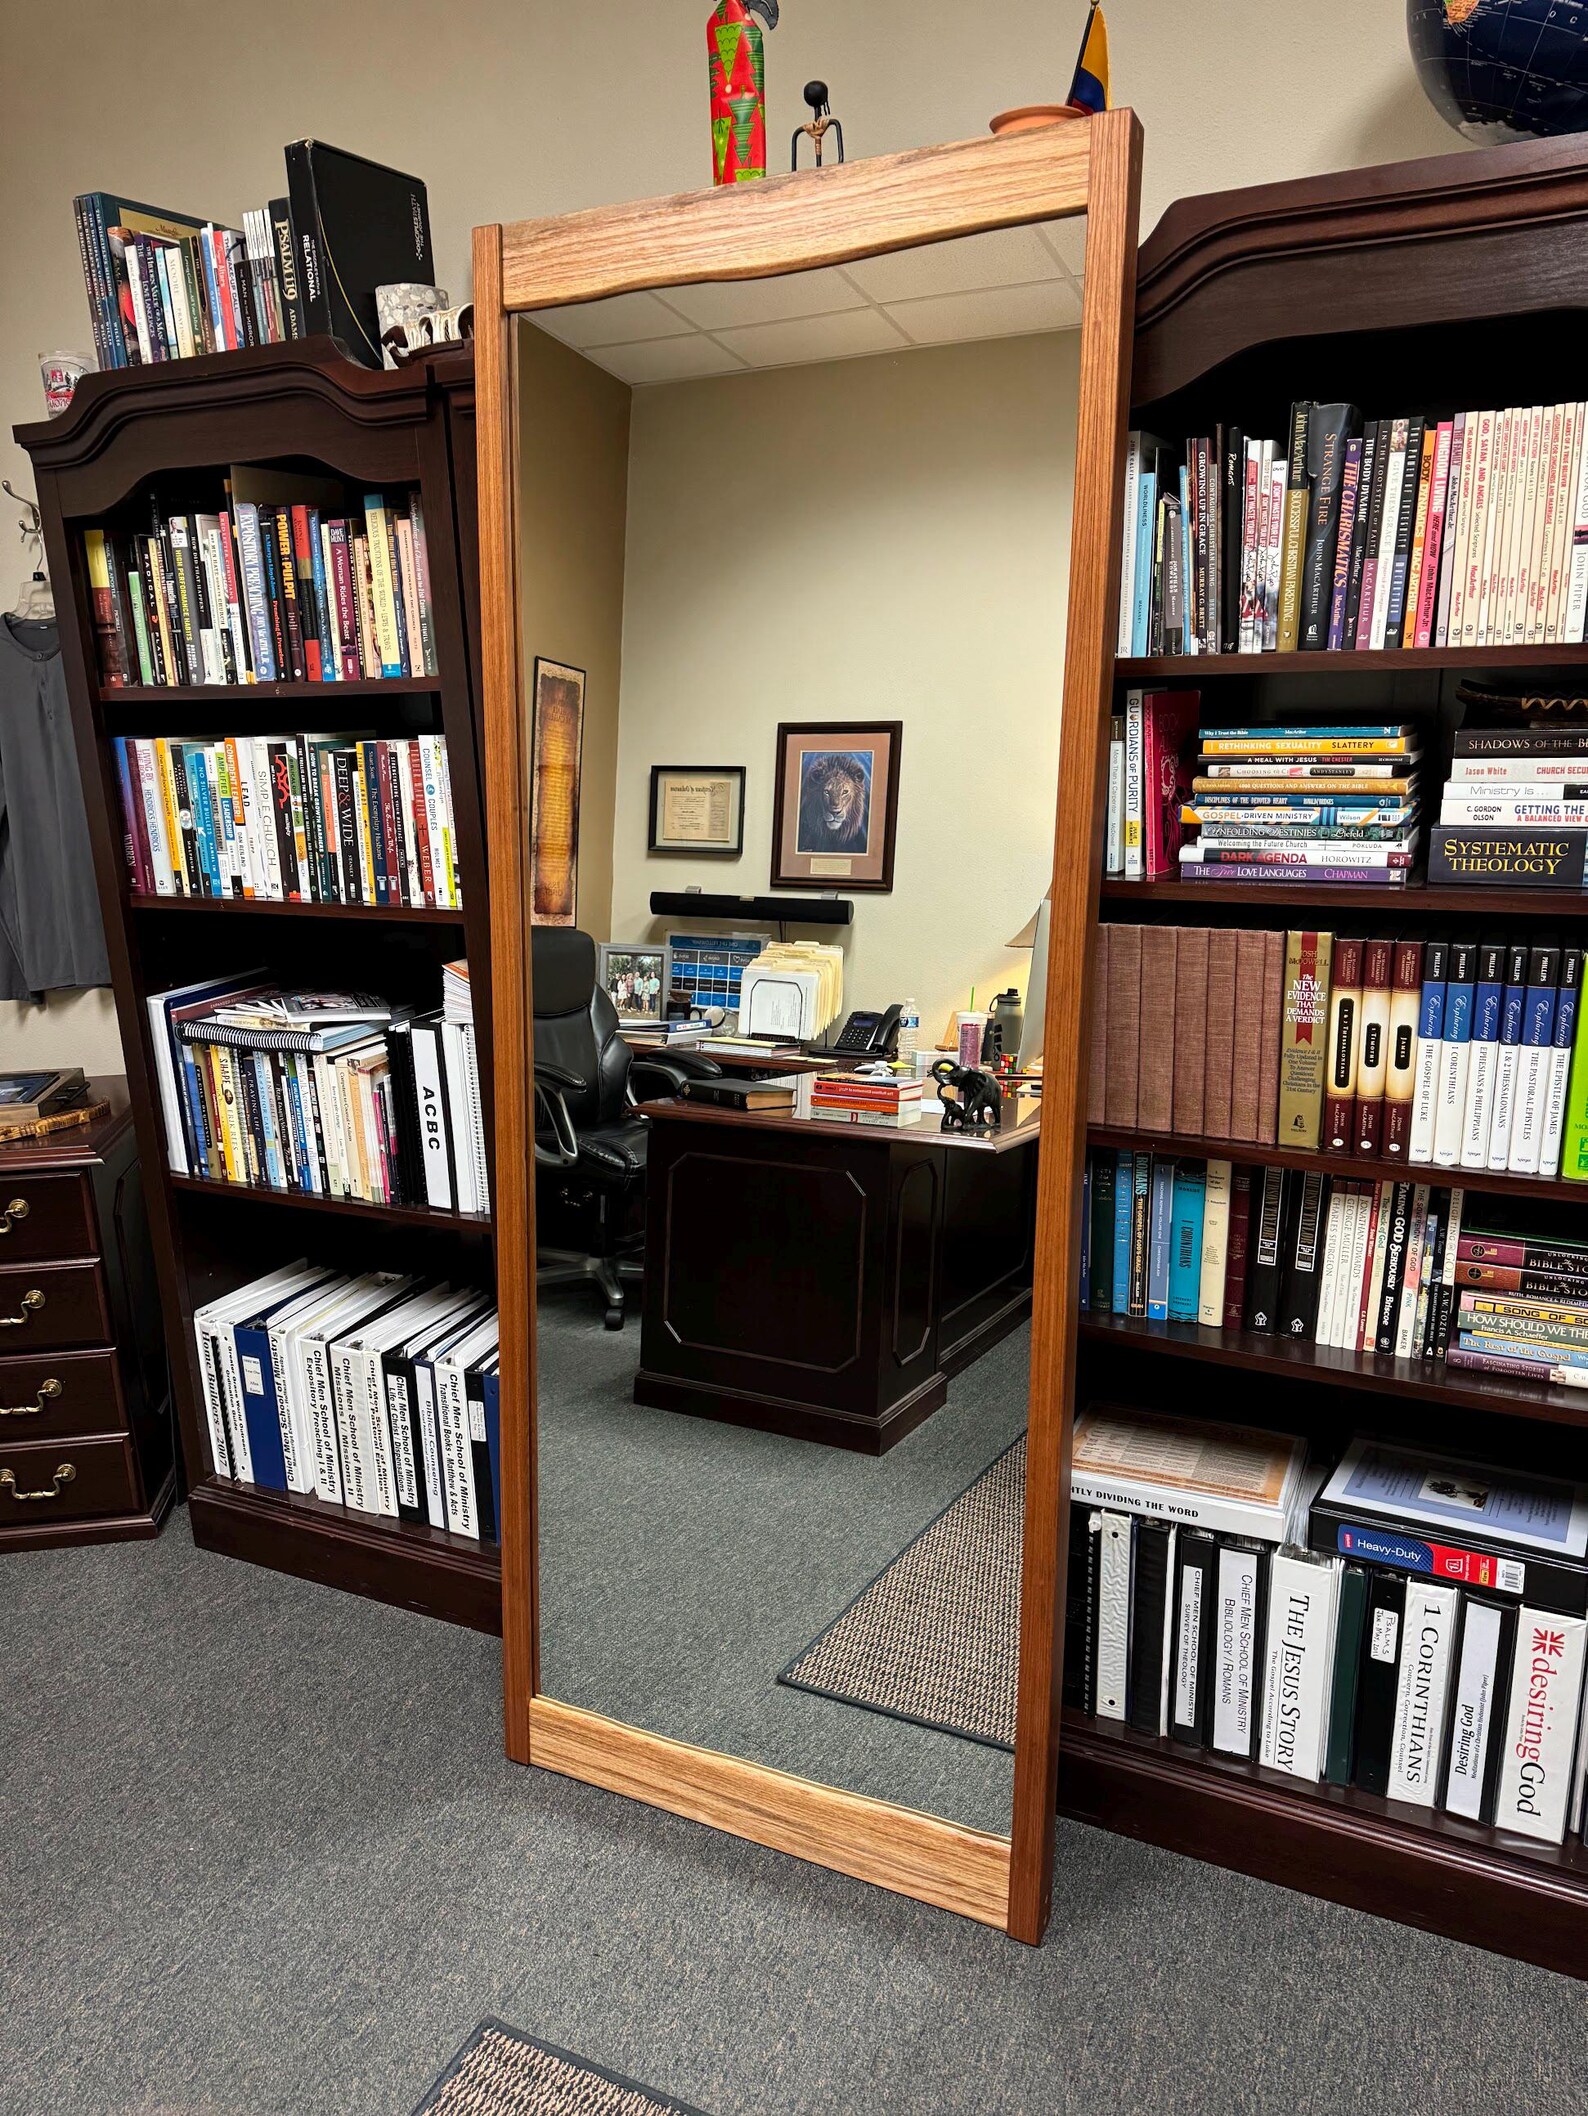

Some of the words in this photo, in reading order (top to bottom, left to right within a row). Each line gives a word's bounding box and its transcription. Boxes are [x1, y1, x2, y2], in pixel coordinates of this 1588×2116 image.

[274, 218, 296, 276] PSALM
[105, 267, 113, 296] MISSION
[226, 257, 236, 290] WAKE-UP
[302, 234, 316, 302] RELATIONAL
[282, 277, 298, 300] 119
[246, 316, 255, 347] MIRROR
[1480, 418, 1490, 438] GOD,
[1320, 433, 1337, 493] STRANGE
[1436, 430, 1450, 478] KINGDOM
[1478, 439, 1488, 465] SATAN,
[1198, 452, 1207, 496] GROWING
[1227, 453, 1237, 486] Romans
[1344, 460, 1357, 488] THE
[1421, 455, 1432, 482] BODY
[1477, 467, 1486, 482] AND
[1141, 485, 1149, 527] WORLDLINESS
[1199, 499, 1207, 510] UP
[1318, 496, 1331, 525] FIRE
[1415, 484, 1428, 538] DYNAMICS
[1432, 480, 1446, 513] LIVING
[1476, 485, 1486, 510] ANGELS
[1199, 512, 1207, 522] IN
[1289, 491, 1302, 540] SUCCESSFUL
[239, 514, 257, 567] EXPOSITORY
[276, 514, 291, 556] POWER
[1199, 524, 1207, 555] GRACE
[1333, 490, 1357, 588] CHARISMATICS
[175, 549, 183, 568] HIGH
[1286, 541, 1300, 579] CHRISTIAN
[1315, 539, 1325, 561] JOHN
[143, 554, 155, 608] RADICAL
[282, 561, 295, 600] PULPIT
[336, 555, 345, 584] Woman
[1574, 552, 1586, 581] JOHN
[178, 568, 190, 617] PERFORMANCE
[242, 568, 264, 616] PREACHING
[339, 585, 348, 606] Rides
[1468, 565, 1478, 599] MacArthur
[1283, 581, 1296, 622] PARENTING
[1572, 583, 1582, 611] PIPER
[183, 618, 192, 641] HABITS
[343, 620, 351, 640] Beast
[155, 632, 163, 666] PLATT
[1218, 742, 1272, 751] RETHINKING
[1332, 741, 1375, 749] SLATTERY
[1469, 739, 1530, 749] SHADOWS
[217, 757, 227, 794] AMPLIFIED
[336, 758, 349, 793] DEEP
[423, 748, 432, 781] COUNSEL
[1129, 763, 1137, 772] OF
[1536, 767, 1565, 775] CHURCH
[225, 744, 237, 786] CONFIDENT
[231, 787, 240, 818] LEADER!
[241, 782, 250, 807] LEAD
[1128, 775, 1138, 813] PURITY
[1470, 786, 1520, 797] Ministry
[338, 792, 351, 806] &
[1514, 805, 1560, 815] GETTING
[1564, 805, 1585, 815] THE
[222, 800, 233, 838] LEADERSHIP
[341, 808, 354, 847] WIDE
[371, 801, 380, 831] Exemplary
[428, 799, 437, 831] COUPLES
[124, 834, 136, 867] WARREN
[263, 816, 276, 866] CHURCH
[375, 833, 383, 860] Husband
[1443, 838, 1570, 857] SYSTEMATIC
[421, 845, 432, 883] WEBER
[1193, 865, 1210, 876] THE
[1220, 851, 1254, 863] DARK
[1256, 853, 1308, 864] AGENDA
[1321, 856, 1372, 864] HOROWITZ
[1448, 858, 1562, 875] THEOLOGY
[1237, 867, 1258, 877] LOVE
[1259, 867, 1307, 878] LANGUAGES
[1324, 869, 1368, 879] CHAPMAN
[1433, 952, 1441, 978] PHILLIPS
[1287, 991, 1326, 1001] EVIDENCE
[1293, 980, 1321, 991] NEW
[1287, 1008, 1325, 1016] DEMANDS
[1295, 1000, 1316, 1009] THAT
[1425, 995, 1440, 1036] Exploring
[1293, 1015, 1325, 1024] VERDICT
[1340, 1026, 1348, 1078] THESSALONIANS
[1425, 1044, 1434, 1059] THE
[219, 1058, 230, 1084] SHAPE
[1423, 1061, 1432, 1089] GOSPEL
[249, 1079, 257, 1114] PRAYING
[292, 1083, 300, 1106] CHURCH
[1422, 1091, 1431, 1101] OF
[295, 1108, 304, 1144] MEMBERSHIP
[423, 1086, 440, 1150] ACBC
[1419, 1102, 1430, 1122] LUKE
[1134, 1156, 1147, 1195] ROMANS
[1396, 1182, 1410, 1215] TAKING
[1393, 1217, 1405, 1243] GOD
[1387, 1243, 1402, 1290] SERIOUSLY
[1440, 1291, 1450, 1307] A.W.
[1526, 1281, 1559, 1292] BIBLE
[1383, 1296, 1393, 1326] Briscoe
[1438, 1310, 1447, 1338] TOZER
[1467, 1314, 1497, 1325] HOW
[1500, 1317, 1545, 1333] SHOULD
[1547, 1325, 1567, 1336] WE
[1400, 1329, 1408, 1350] BAKER
[313, 1350, 323, 1377] Chief
[201, 1331, 212, 1369] Home
[208, 1372, 220, 1425] Builders
[217, 1437, 227, 1466] 2007
[317, 1380, 325, 1400] Men
[450, 1373, 459, 1403] Chief
[306, 1357, 317, 1409] Expository
[313, 1411, 324, 1459] Preaching
[320, 1404, 330, 1435] School
[425, 1400, 435, 1438] Biblical
[452, 1406, 461, 1429] Men
[323, 1437, 331, 1451] of
[455, 1432, 466, 1469] School
[325, 1454, 337, 1494] Ministry
[429, 1440, 439, 1496] Counseling
[459, 1472, 467, 1483] of
[460, 1486, 470, 1530] Ministry
[1096, 1491, 1141, 1506] DIVIDING
[1145, 1501, 1165, 1511] THE
[1168, 1505, 1199, 1518] WORD
[1357, 1538, 1422, 1563] Heavy-Duty
[1240, 1574, 1253, 1605] CHIEF
[1241, 1607, 1252, 1629] MEN
[1287, 1595, 1310, 1639] THE
[1423, 1604, 1440, 1617] 1
[1223, 1598, 1235, 1656] BIBLIOLOGY
[1238, 1632, 1251, 1671] SCHOOL
[1222, 1663, 1234, 1705] ROMANS
[1239, 1674, 1248, 1686] OF
[1281, 1639, 1305, 1700] JESUS
[1237, 1689, 1249, 1734] MINISTRY
[1406, 1627, 1439, 1783] CORINTHIANS
[1460, 1704, 1474, 1727] God
[1277, 1704, 1300, 1771] STORY
[1455, 1728, 1475, 1775] Desiring
[1516, 1657, 1558, 1817] desiringGod
